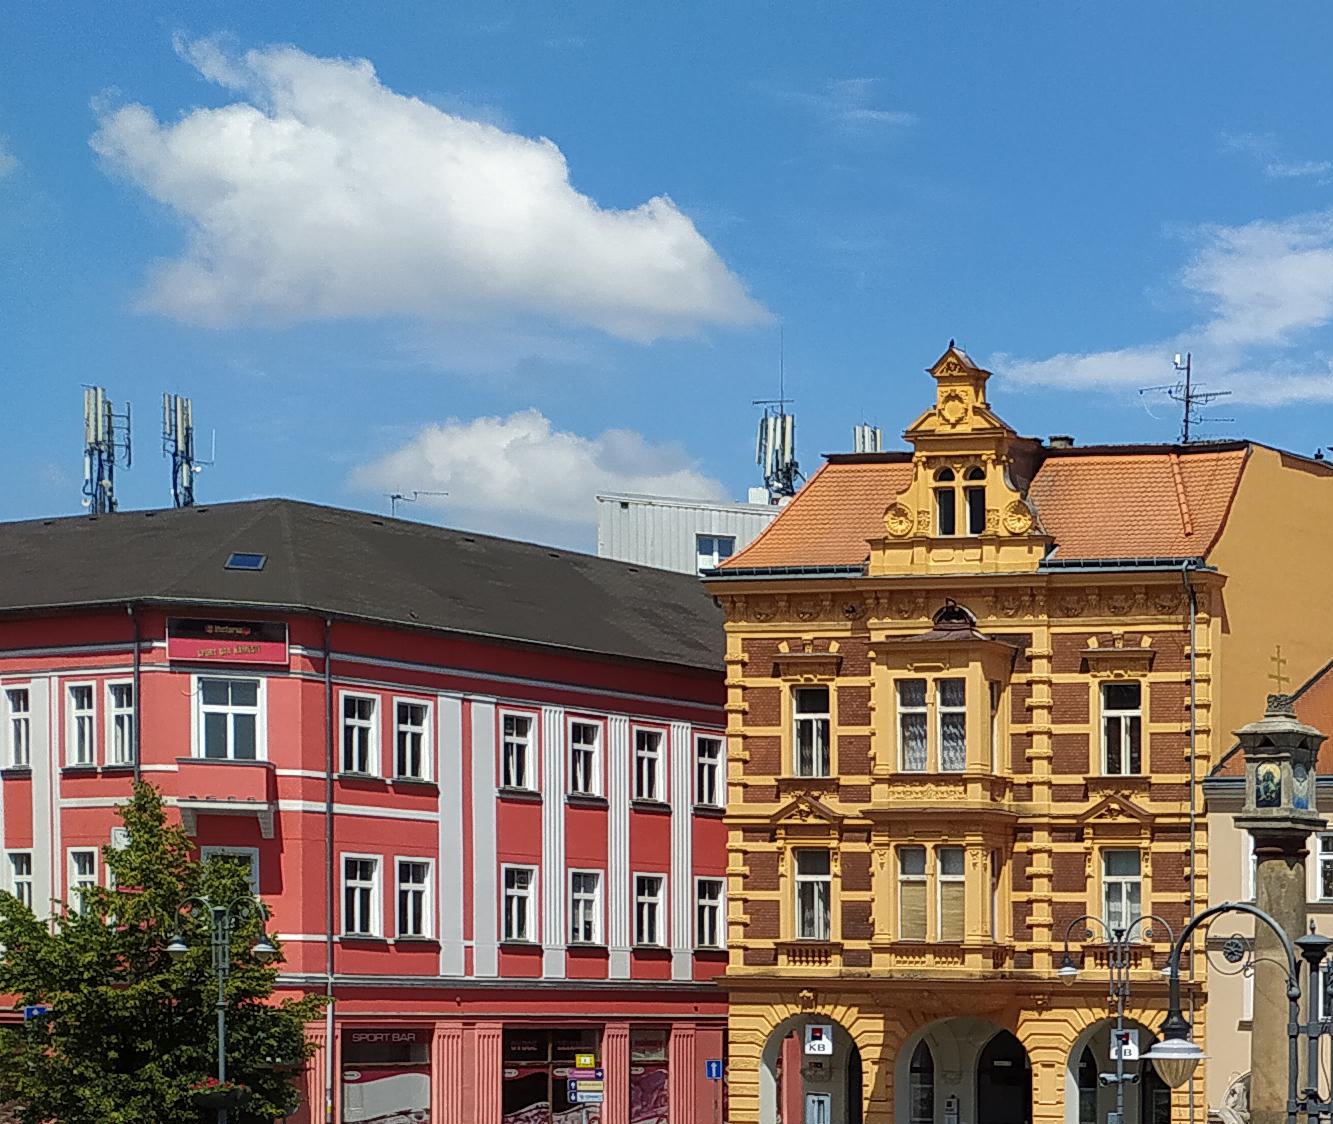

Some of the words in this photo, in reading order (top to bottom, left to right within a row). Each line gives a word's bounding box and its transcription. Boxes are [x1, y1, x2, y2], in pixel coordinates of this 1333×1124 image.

[352, 1032, 391, 1043] SPORT
[392, 1032, 416, 1042] BAR
[809, 1043, 825, 1051] KB
